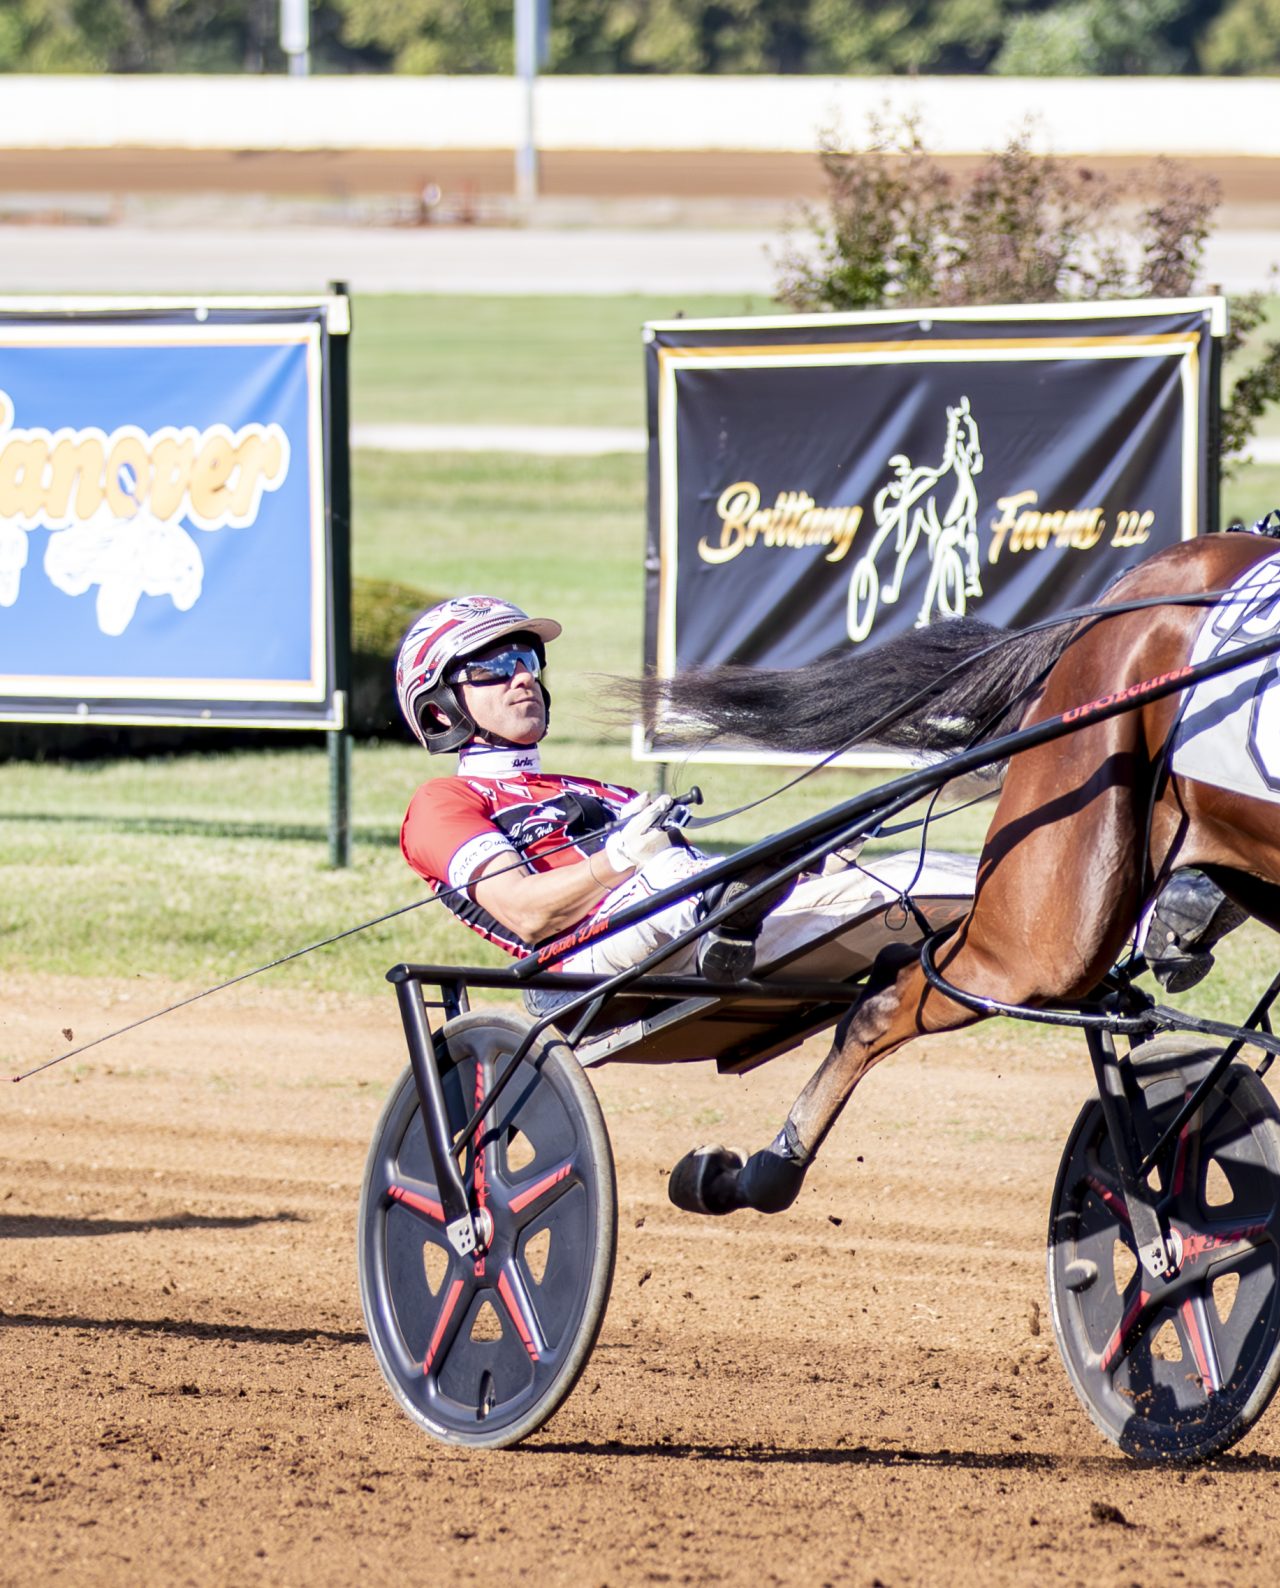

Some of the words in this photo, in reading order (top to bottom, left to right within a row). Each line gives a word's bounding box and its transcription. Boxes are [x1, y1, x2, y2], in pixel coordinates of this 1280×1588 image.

[0, 391, 289, 529] anover
[698, 481, 863, 564] Brittany
[988, 489, 1106, 565] Farms
[1110, 509, 1155, 548] LLC
